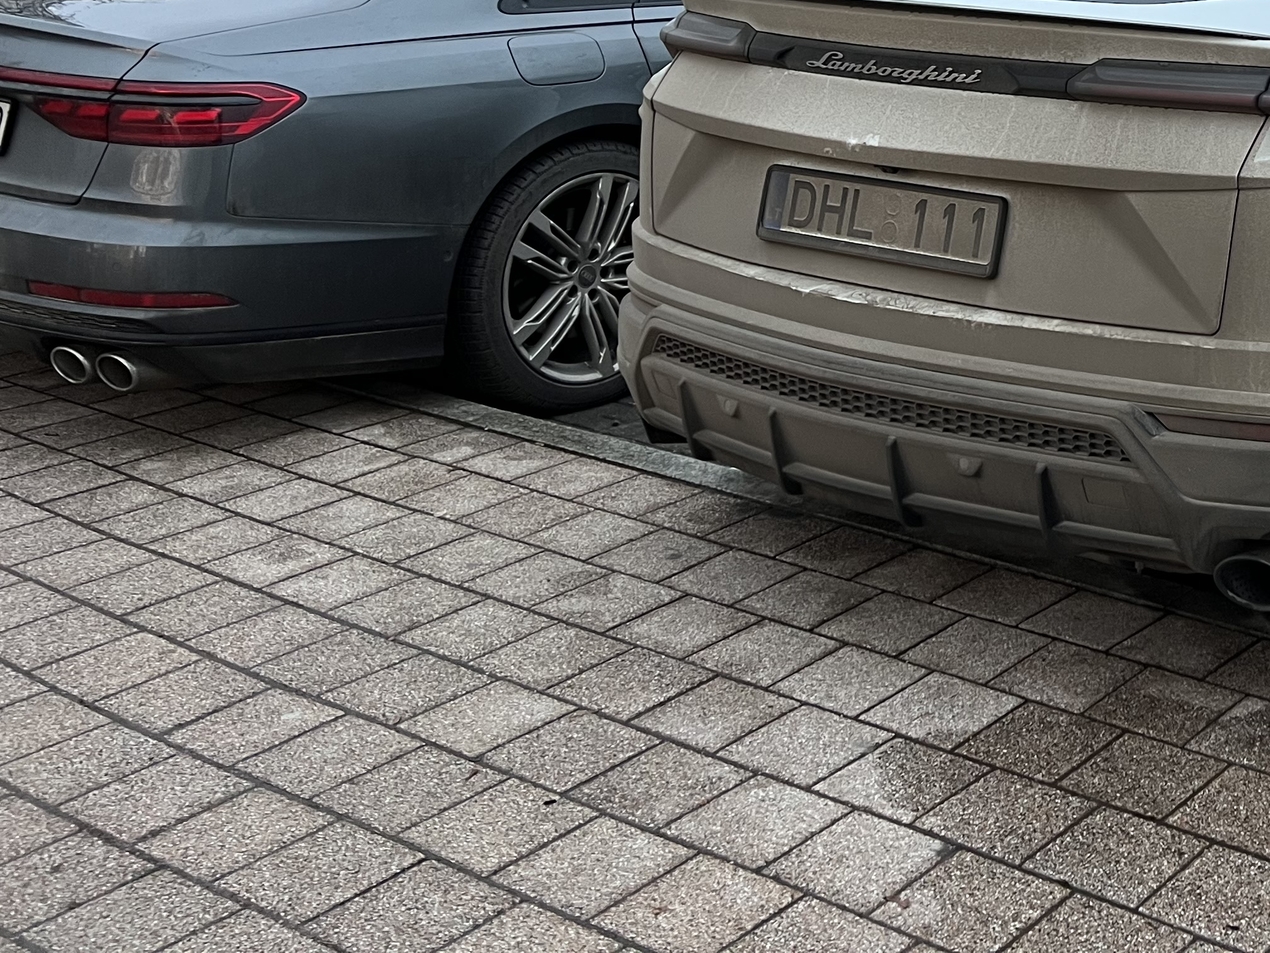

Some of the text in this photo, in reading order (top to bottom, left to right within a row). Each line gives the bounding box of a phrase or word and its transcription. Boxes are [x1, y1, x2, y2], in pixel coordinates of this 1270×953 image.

[806, 51, 982, 83] Lamborghini
[787, 179, 986, 259] DHL 111
